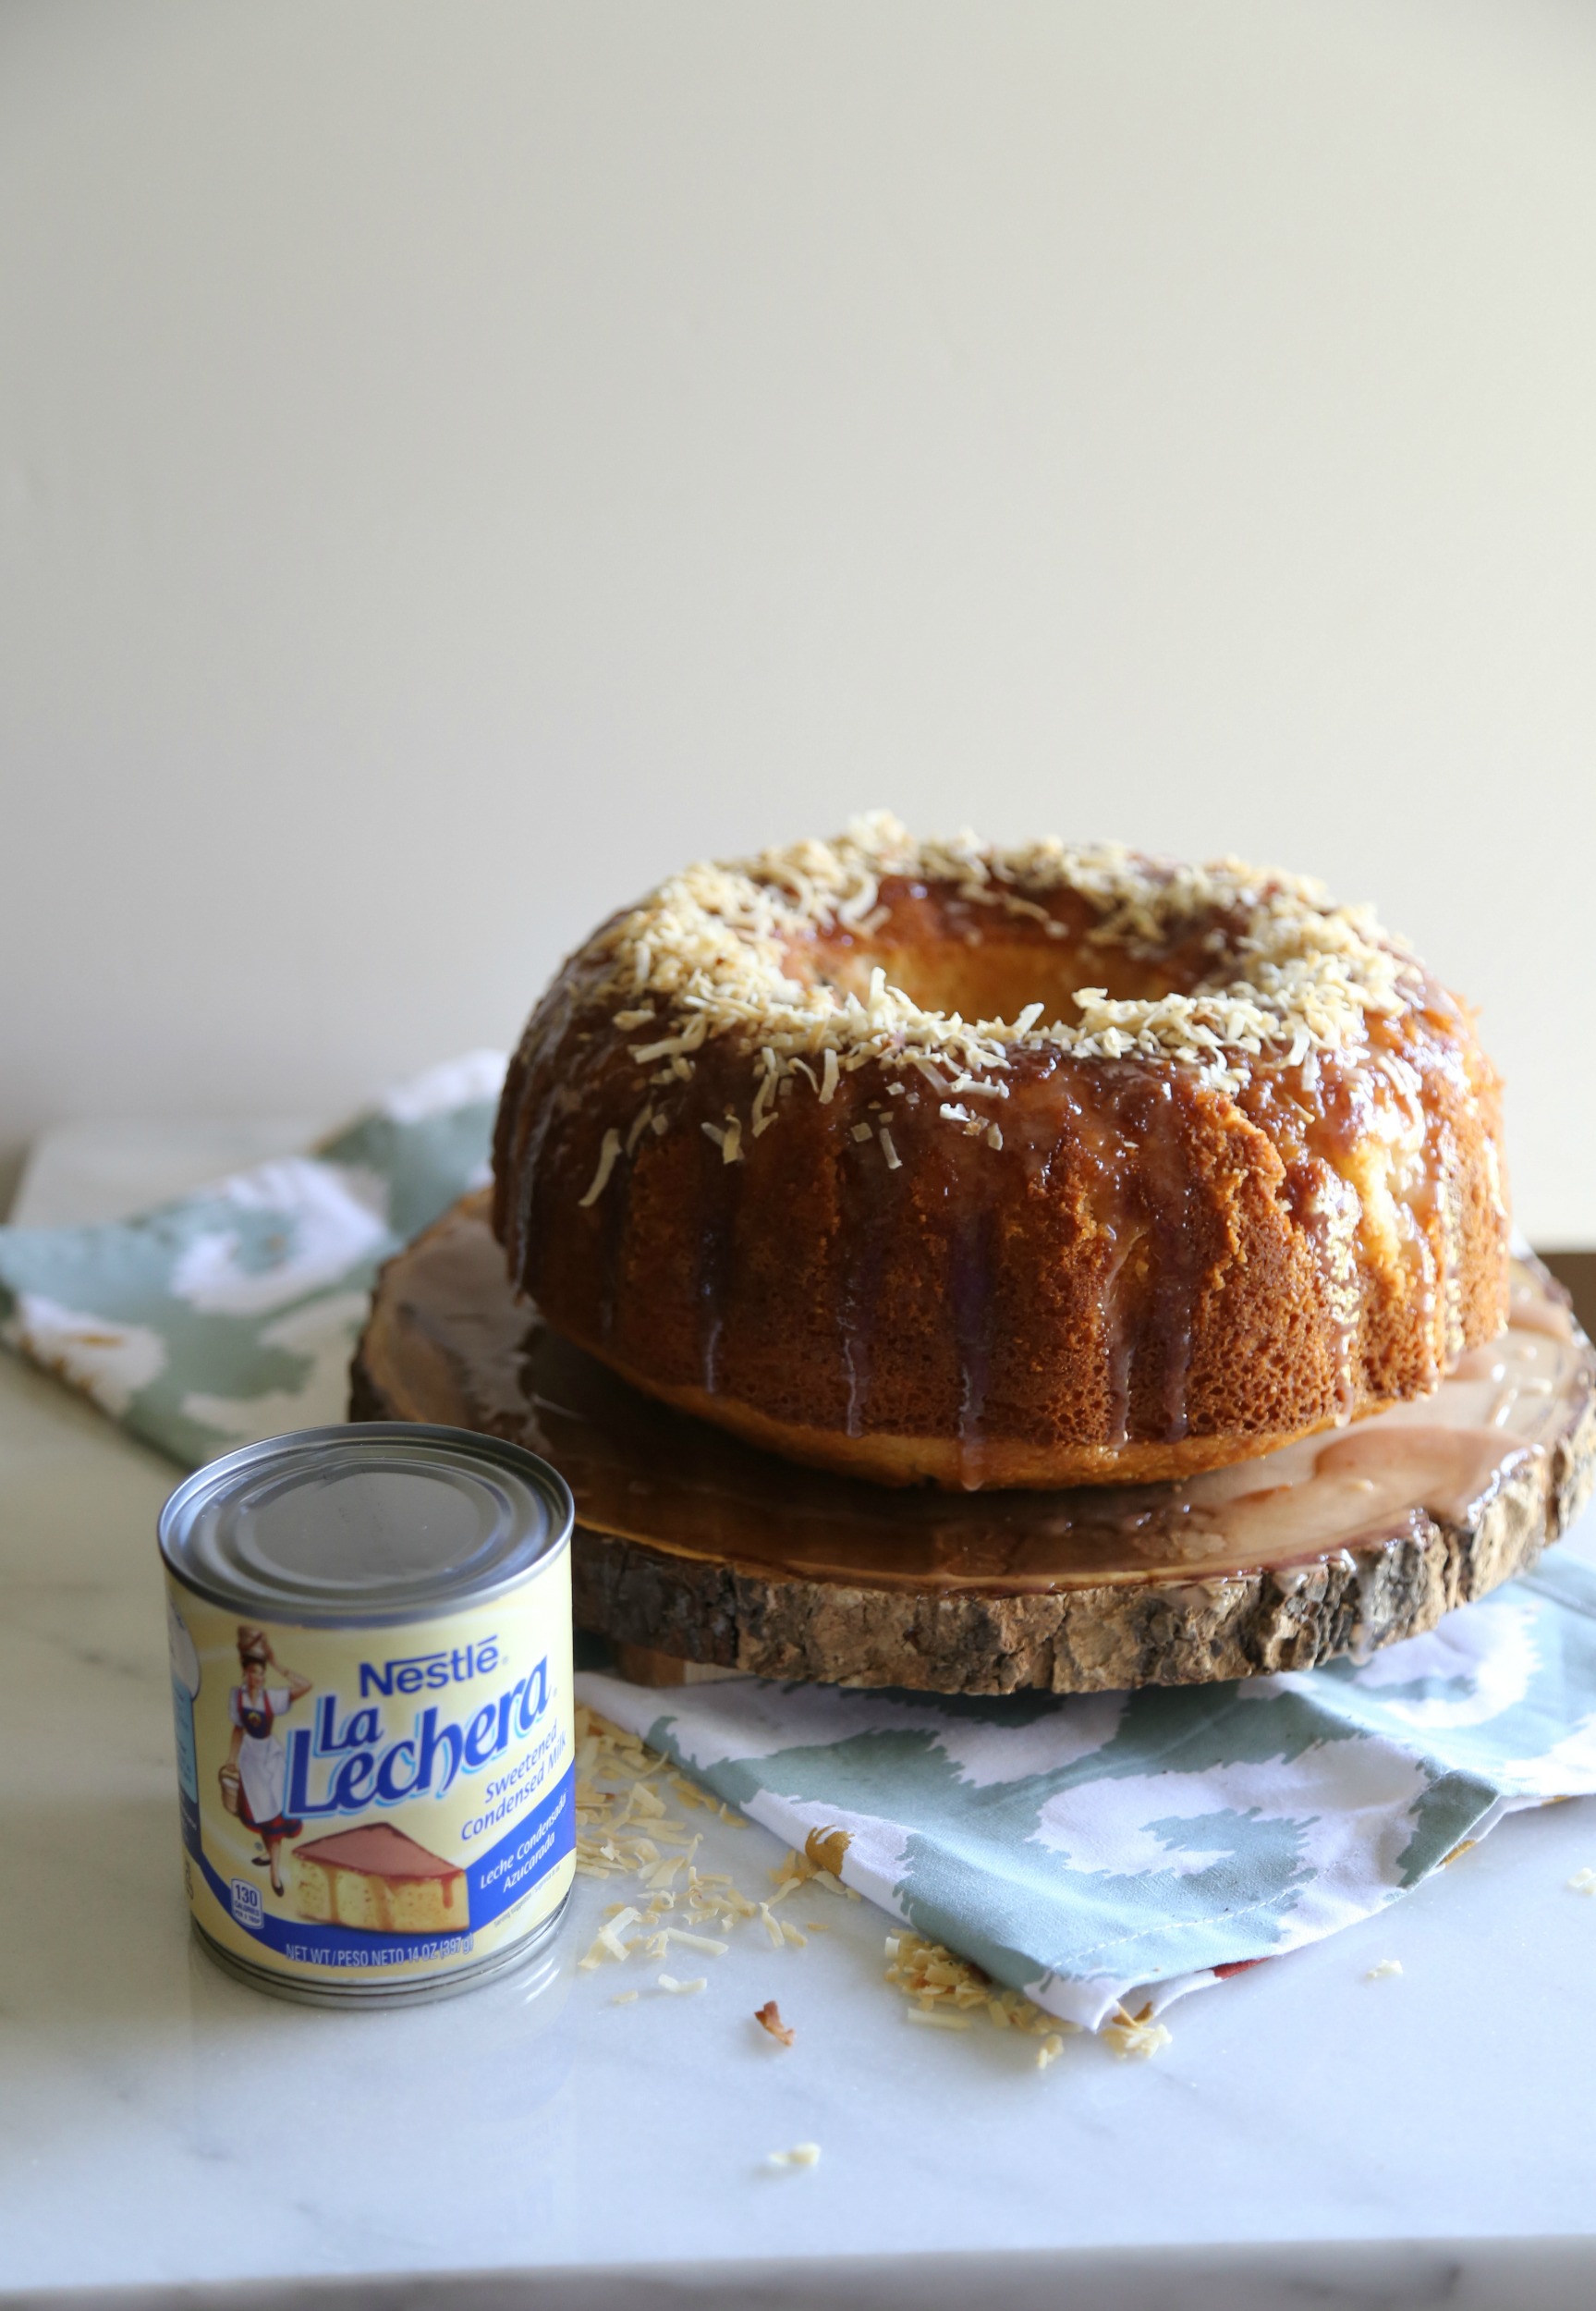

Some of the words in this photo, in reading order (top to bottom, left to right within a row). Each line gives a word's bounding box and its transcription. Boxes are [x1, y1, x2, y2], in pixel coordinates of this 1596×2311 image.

[284, 1654, 553, 1818] Lechera
[315, 1695, 384, 1755] La
[462, 1761, 544, 1840] Condensed
[548, 1729, 567, 1774] Milk
[480, 1854, 515, 1889] Leche
[503, 1832, 554, 1893] Azucarada
[236, 1884, 258, 1907] 130
[286, 1943, 308, 1961] NET
[372, 1948, 405, 1965] NETO
[408, 1945, 420, 1962] 14
[422, 1943, 437, 1959] OZ
